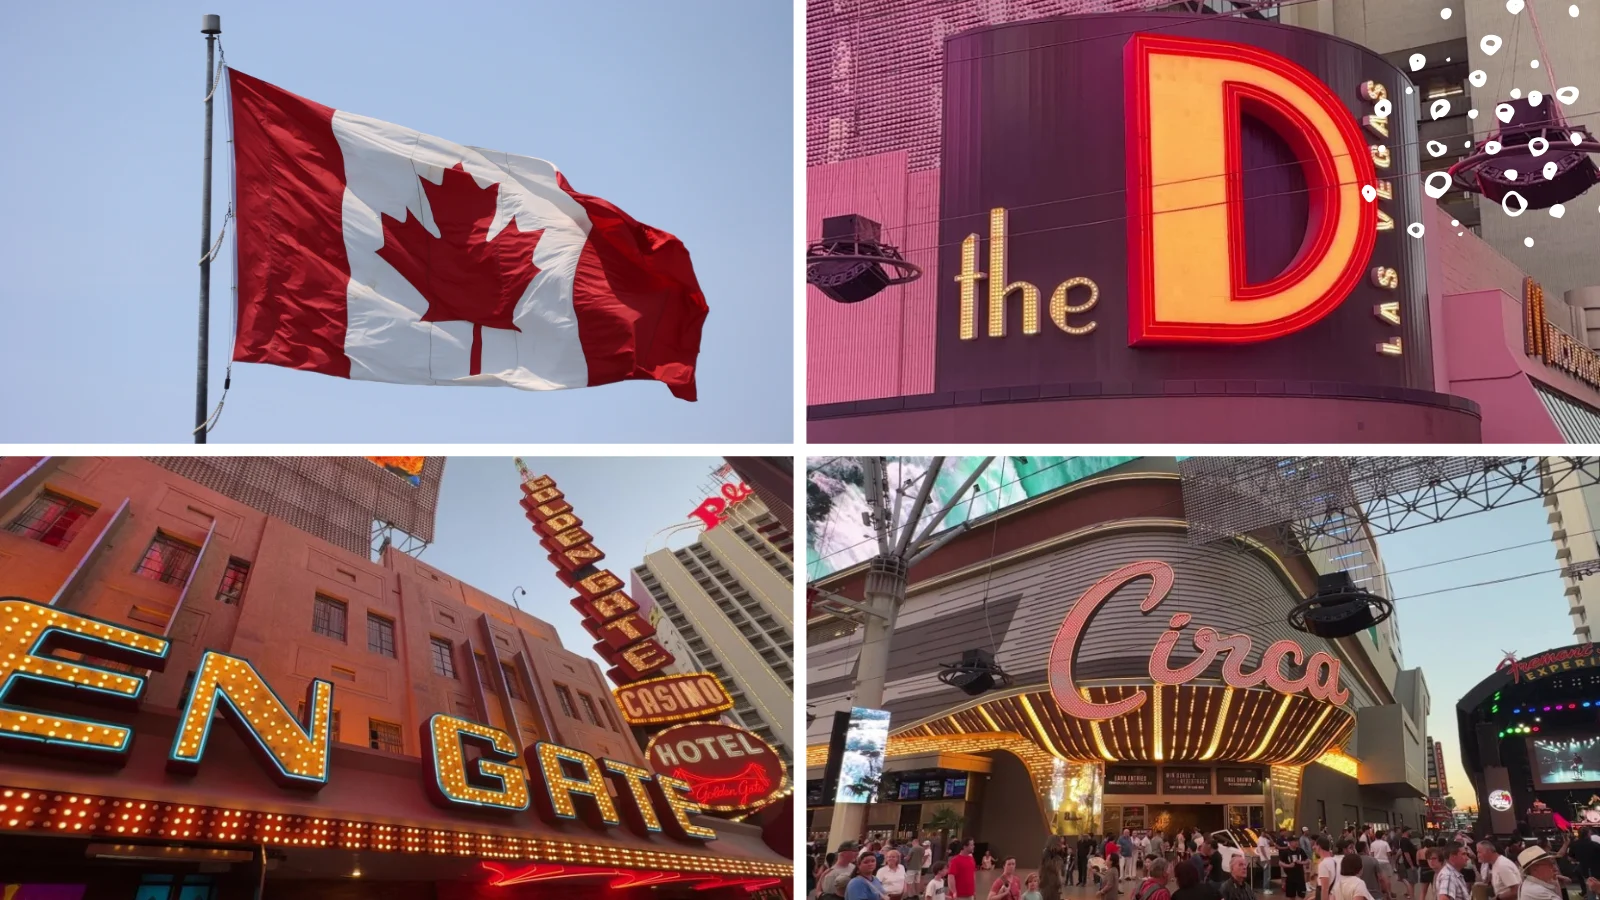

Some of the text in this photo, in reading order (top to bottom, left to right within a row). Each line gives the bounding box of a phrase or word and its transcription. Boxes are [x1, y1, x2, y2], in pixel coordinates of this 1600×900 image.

[954, 32, 1378, 347] the D
[1360, 80, 1402, 355] LAS VEGAS
[526, 475, 668, 673] GOLDEN GATE
[1048, 560, 1349, 720] Circa
[1495, 642, 1593, 684] Fremont
[1525, 658, 1600, 681] EXPERI
[620, 677, 724, 718] CASINO
[427, 712, 718, 840] GATE
[655, 732, 764, 767] HOTEL
[696, 779, 767, 805] Golden Gate
